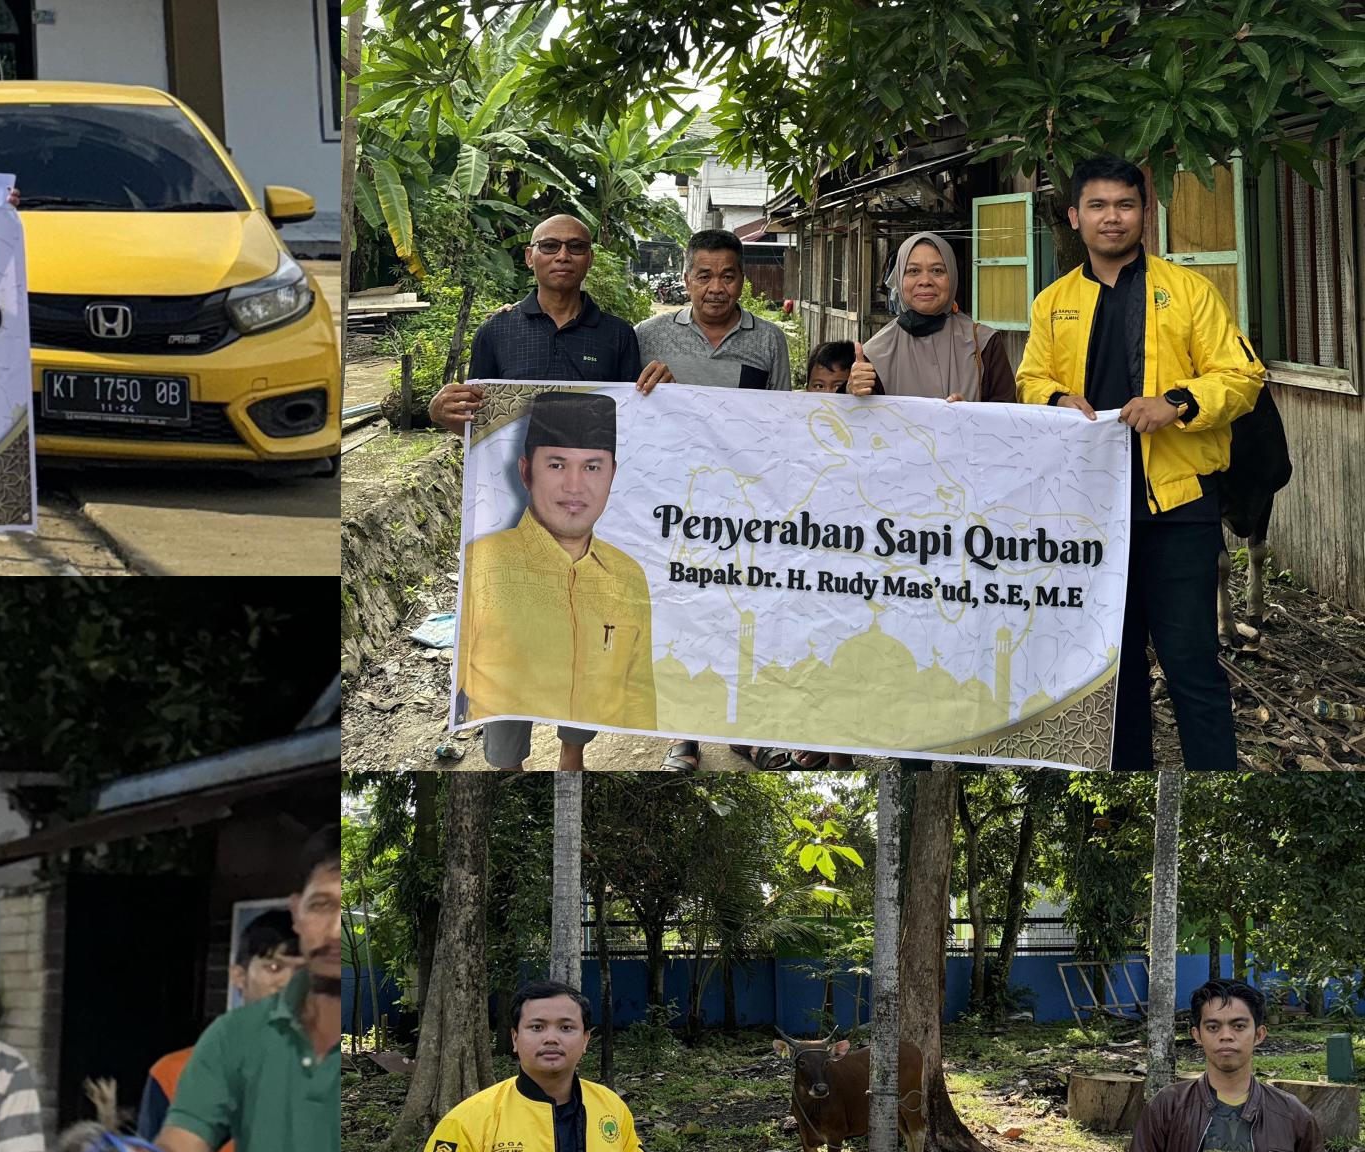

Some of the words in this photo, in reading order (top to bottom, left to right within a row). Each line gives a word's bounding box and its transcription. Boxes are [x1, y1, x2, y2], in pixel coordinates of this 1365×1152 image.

[53, 374, 77, 398] KT
[94, 377, 141, 402] 1750
[653, 505, 864, 553] Penyerahan
[874, 518, 951, 565] Sapi
[965, 525, 1103, 570] Qurban
[669, 562, 742, 588] Bapak
[747, 566, 781, 588] Dr.
[787, 569, 811, 591] H.
[817, 571, 878, 600] Rudy
[984, 583, 1030, 611] S.E,
[1035, 586, 1083, 608] M.E
